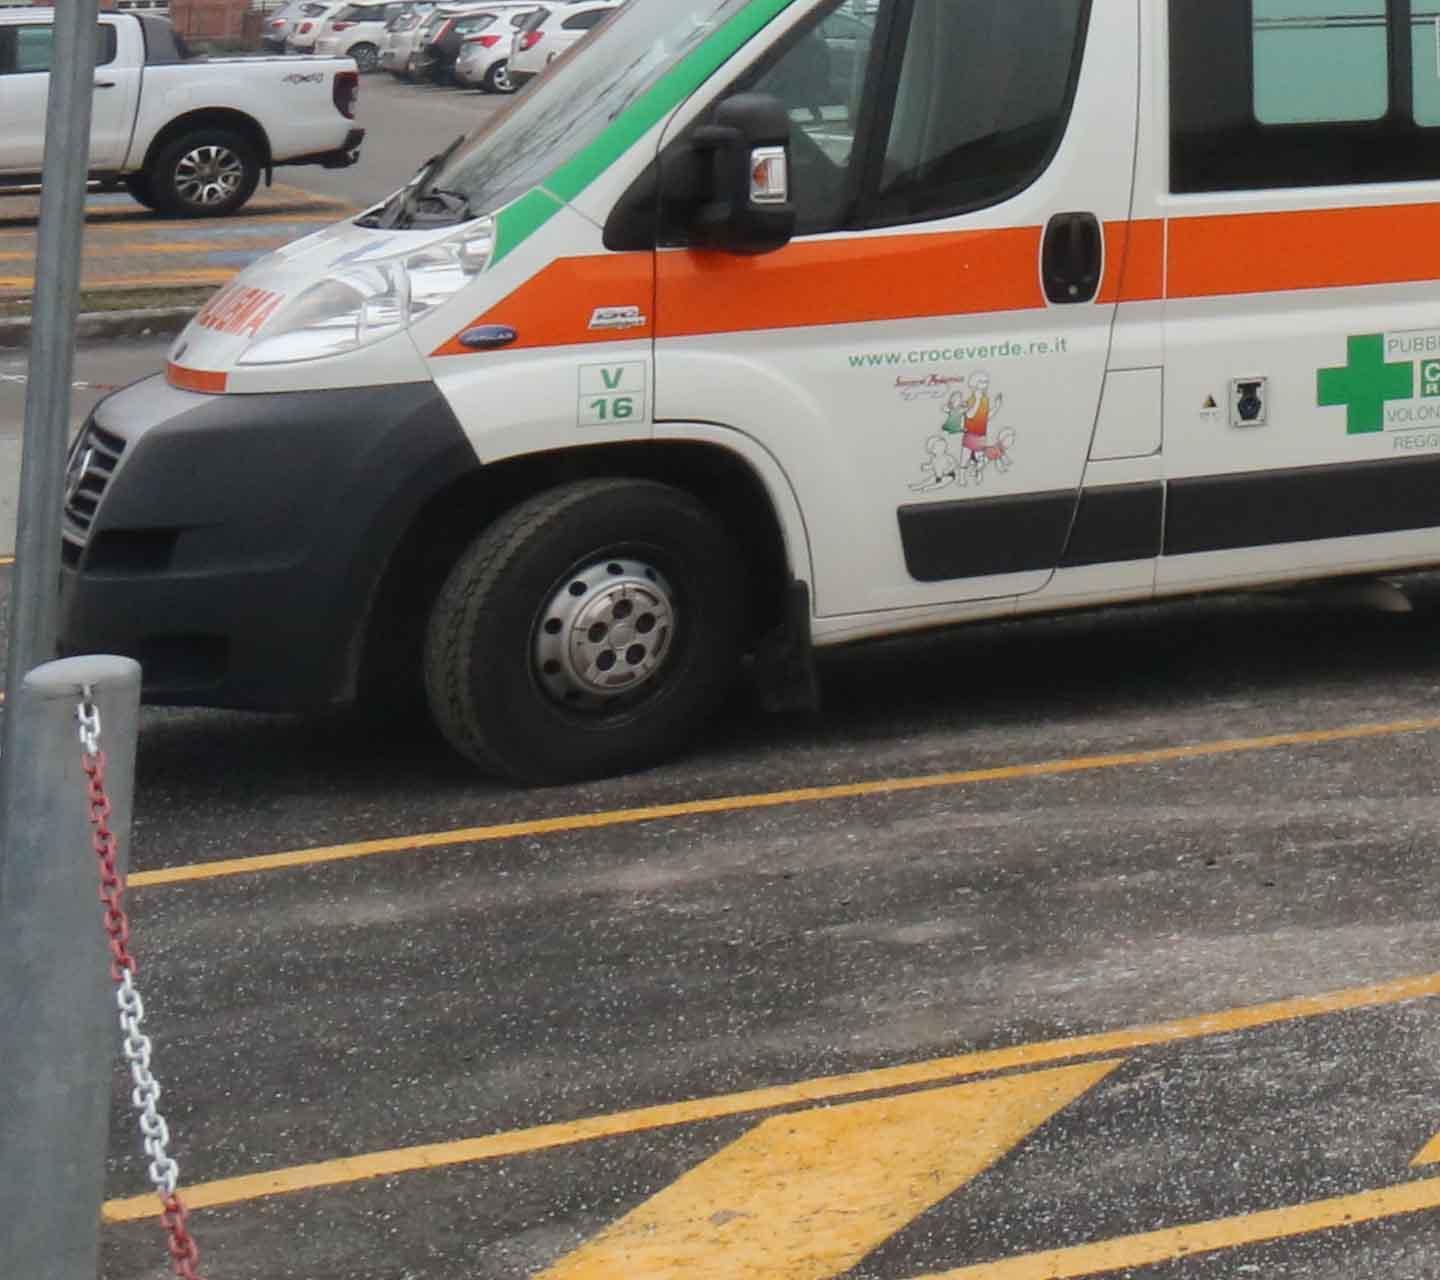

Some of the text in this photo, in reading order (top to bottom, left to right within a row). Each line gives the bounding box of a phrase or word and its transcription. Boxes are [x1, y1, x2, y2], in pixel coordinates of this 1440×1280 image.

[848, 337, 1068, 368] www.croceverde.re.it
[600, 367, 624, 390] V
[590, 397, 633, 420] 16
